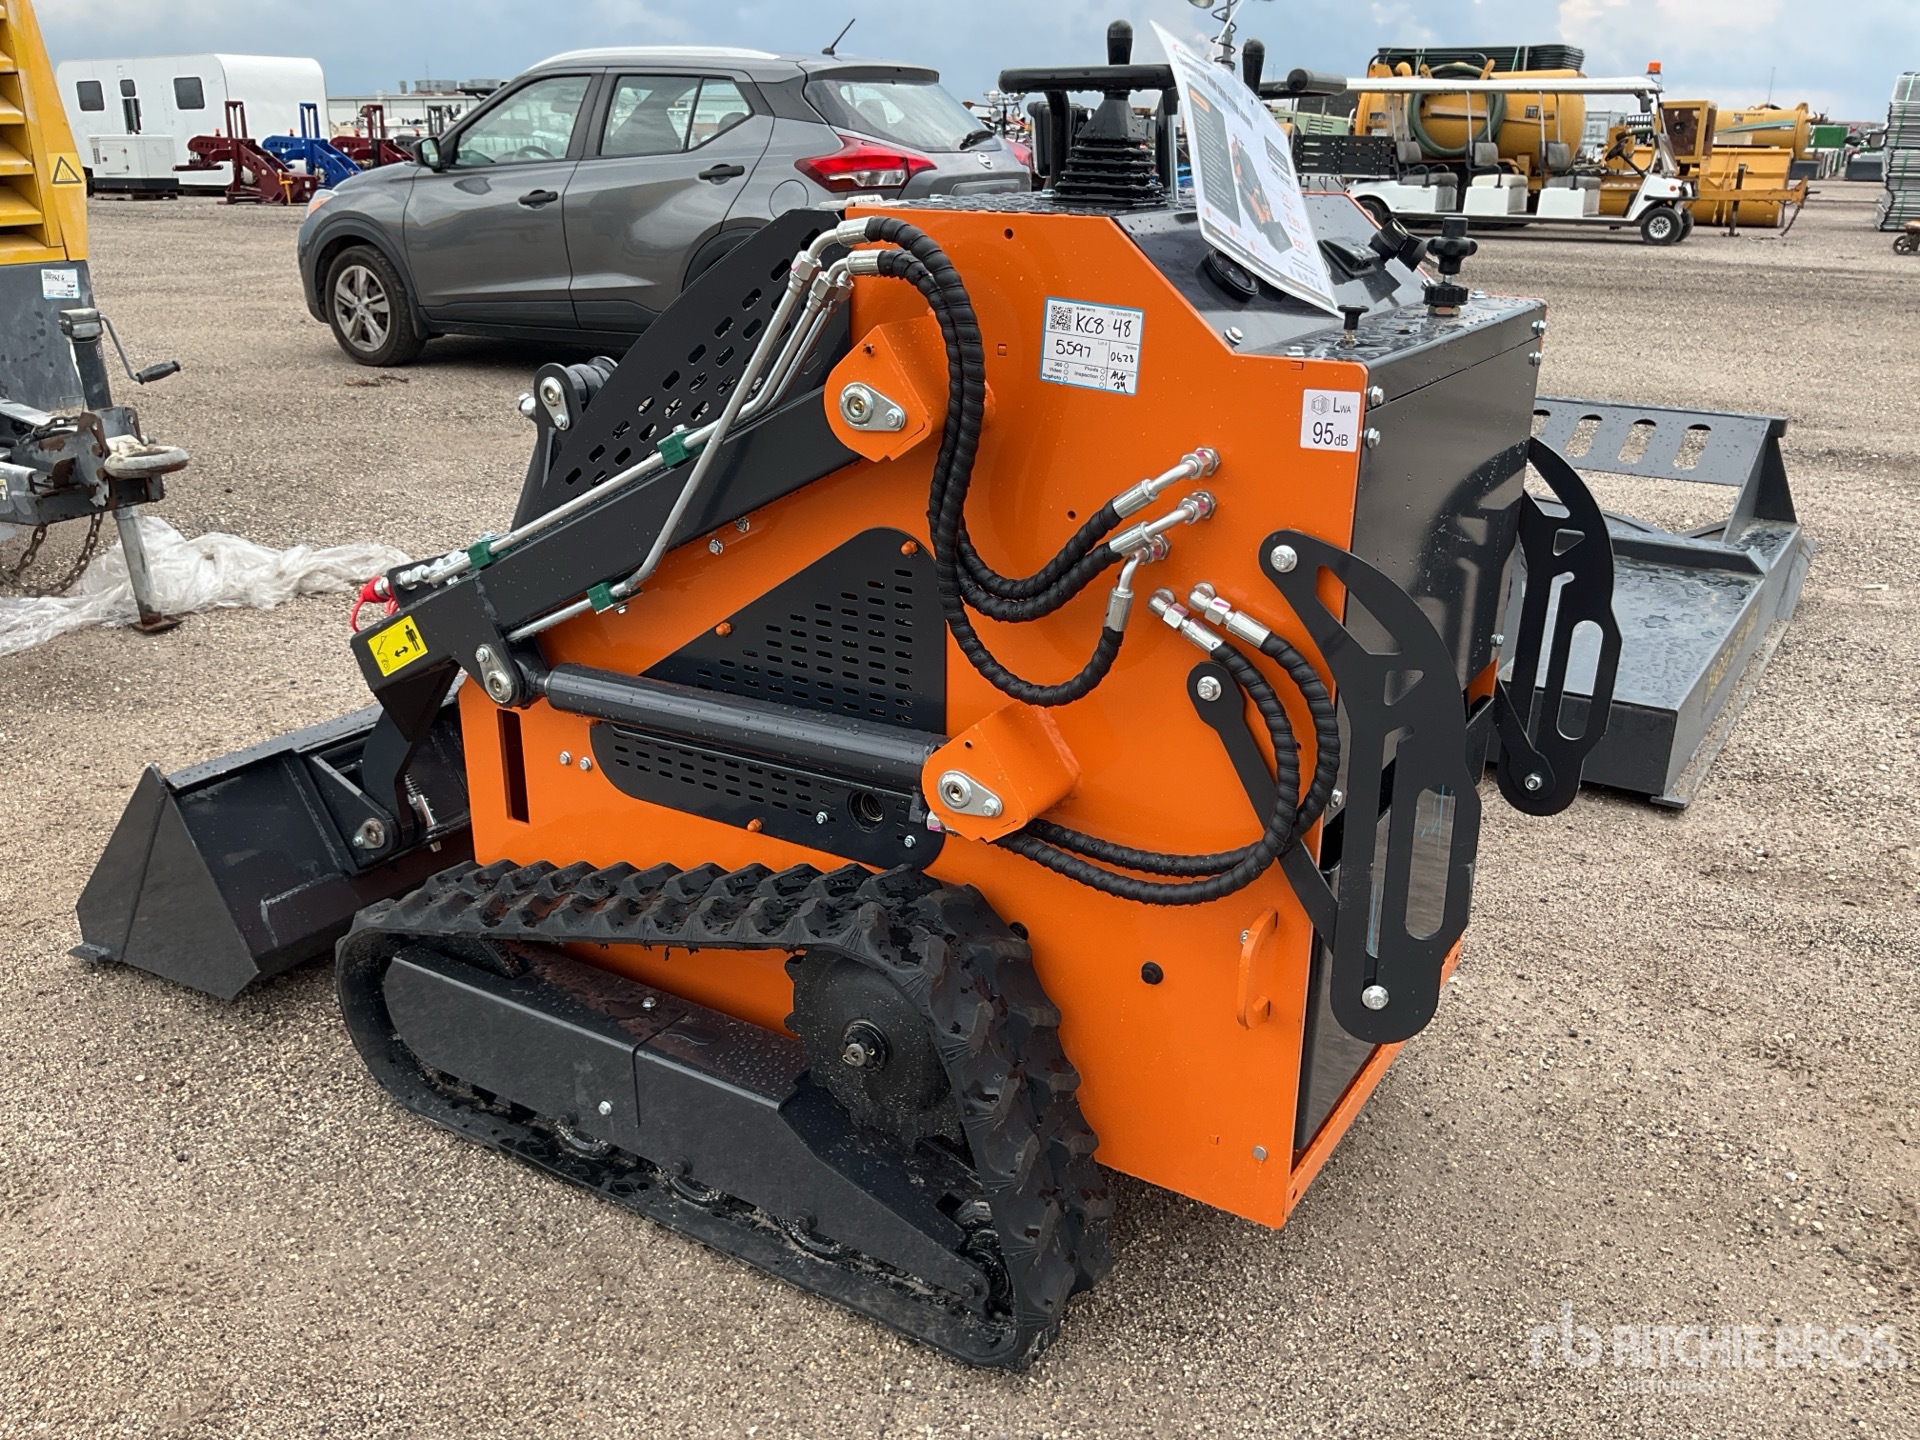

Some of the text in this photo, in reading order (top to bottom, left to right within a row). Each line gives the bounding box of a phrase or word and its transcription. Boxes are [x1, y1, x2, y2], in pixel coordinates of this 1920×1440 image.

[1075, 312, 1132, 337] KC8 48
[1056, 339, 1091, 358] 5597
